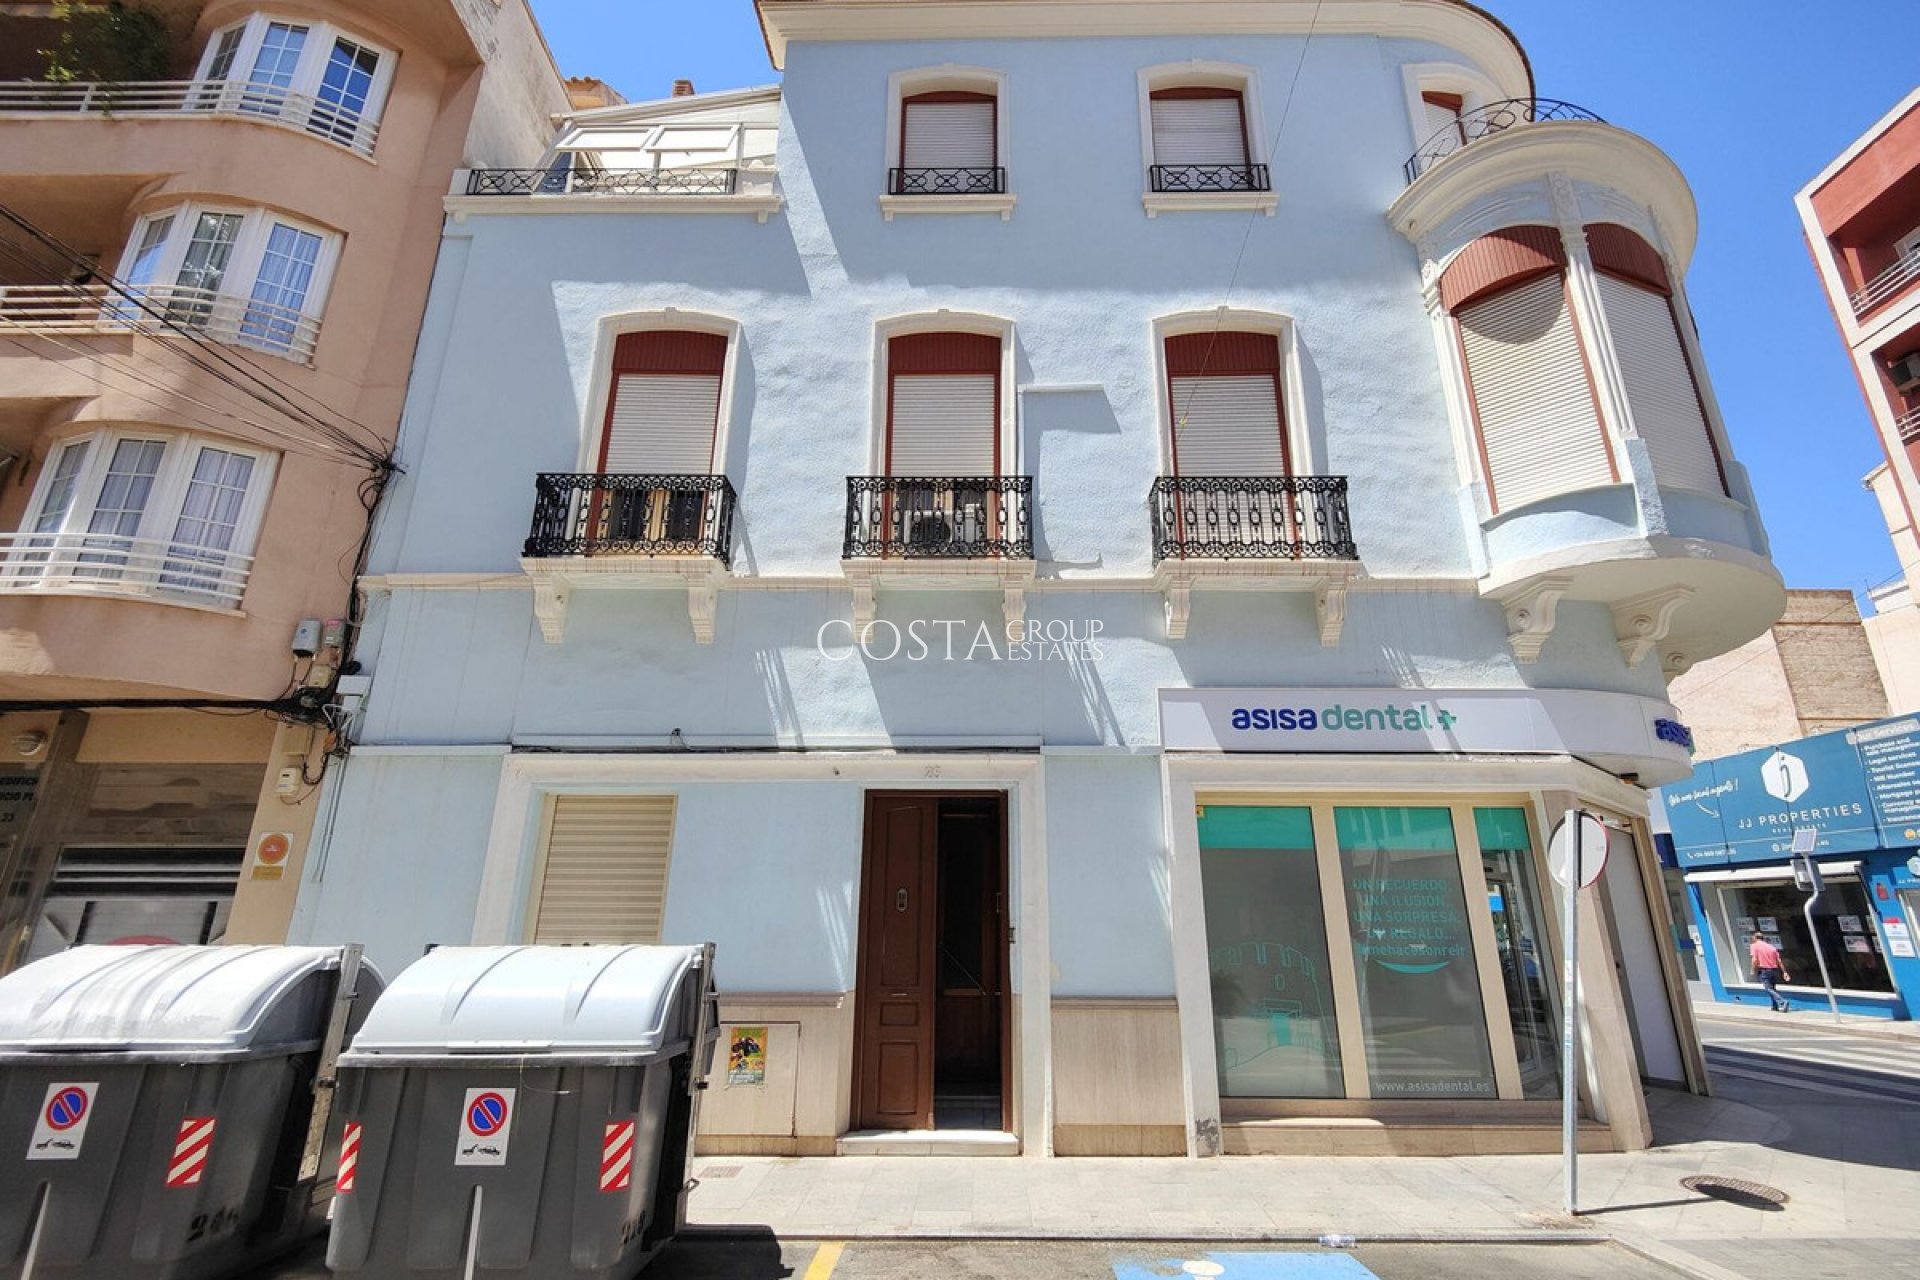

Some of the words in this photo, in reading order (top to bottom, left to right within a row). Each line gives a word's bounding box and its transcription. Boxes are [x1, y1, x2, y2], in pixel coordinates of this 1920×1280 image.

[1232, 708, 1318, 730] asisa
[1321, 704, 1434, 731] dental
[1759, 802, 1862, 826] PROPERTIES
[1376, 1080, 1489, 1093] www.asisadental.es
